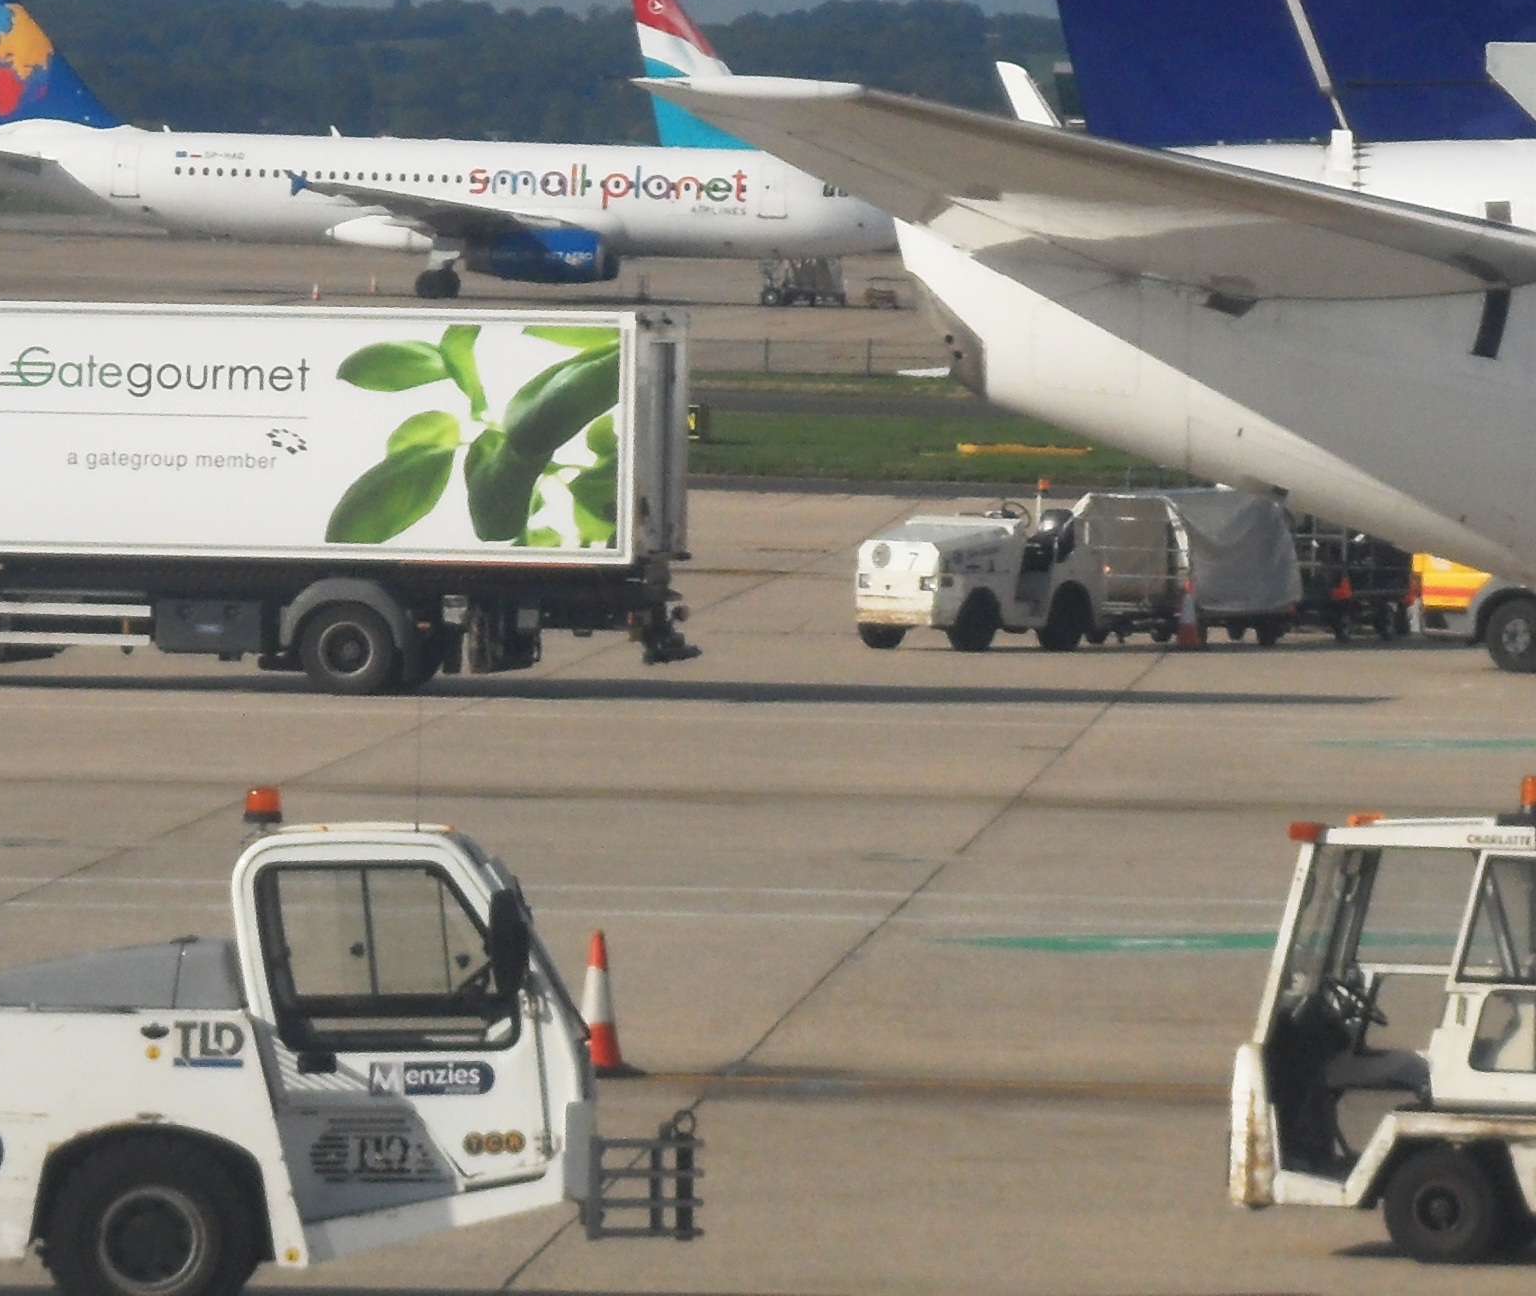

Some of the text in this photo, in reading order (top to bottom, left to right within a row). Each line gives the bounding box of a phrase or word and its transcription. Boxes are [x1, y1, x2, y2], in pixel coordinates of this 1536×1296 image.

[602, 165, 748, 210] planet
[67, 450, 276, 470] a gategroup member
[174, 1021, 244, 1060] TLD
[372, 1063, 480, 1091] Menzies
